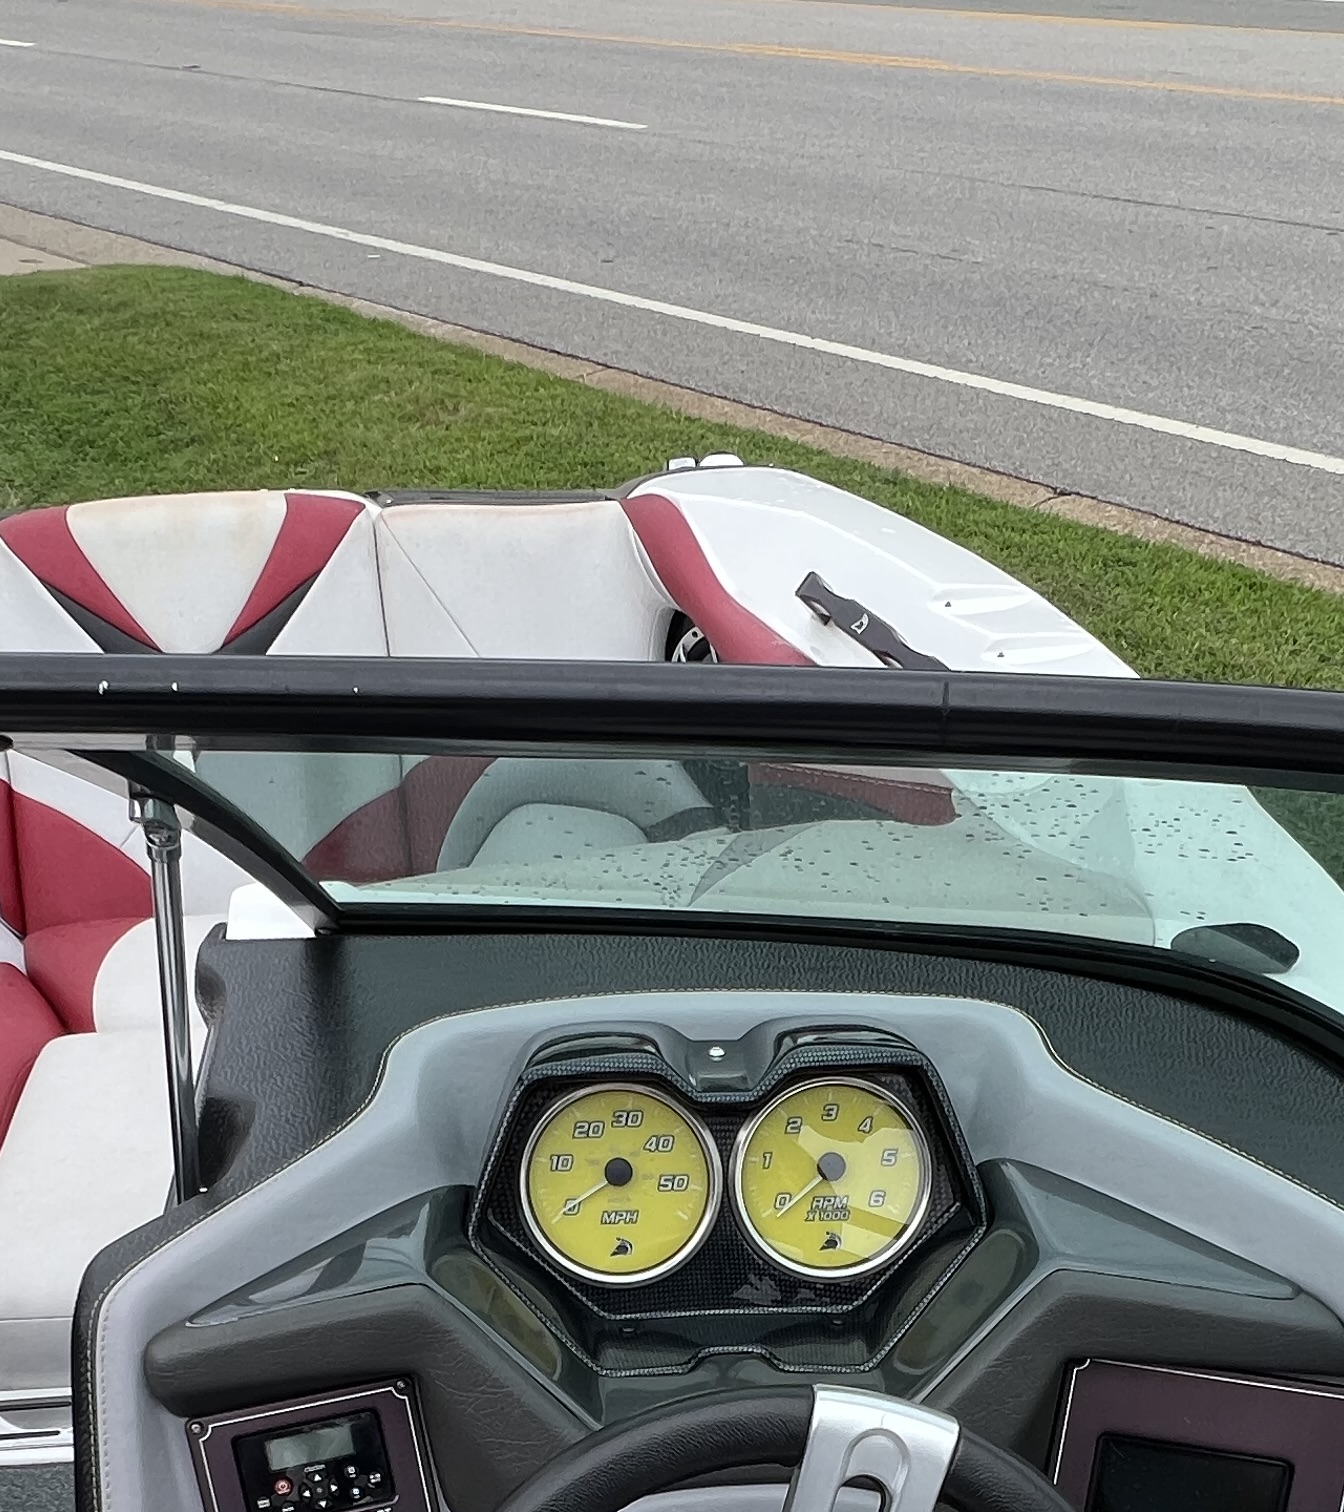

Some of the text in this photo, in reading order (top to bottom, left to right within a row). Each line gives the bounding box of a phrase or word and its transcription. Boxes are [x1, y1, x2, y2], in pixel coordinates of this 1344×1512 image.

[611, 1110, 643, 1127] 30
[821, 1104, 839, 1121] 3
[573, 1121, 605, 1138] 20
[784, 1116, 803, 1134] 2
[857, 1116, 874, 1133] 4
[643, 1134, 675, 1152] 40
[550, 1154, 574, 1172] 10
[762, 1152, 773, 1169] 1
[880, 1149, 898, 1166] 5
[657, 1174, 689, 1192] 50
[774, 1192, 792, 1209] 0
[810, 1195, 849, 1210] RPM
[868, 1190, 886, 1207] 6
[601, 1210, 639, 1224] MPH
